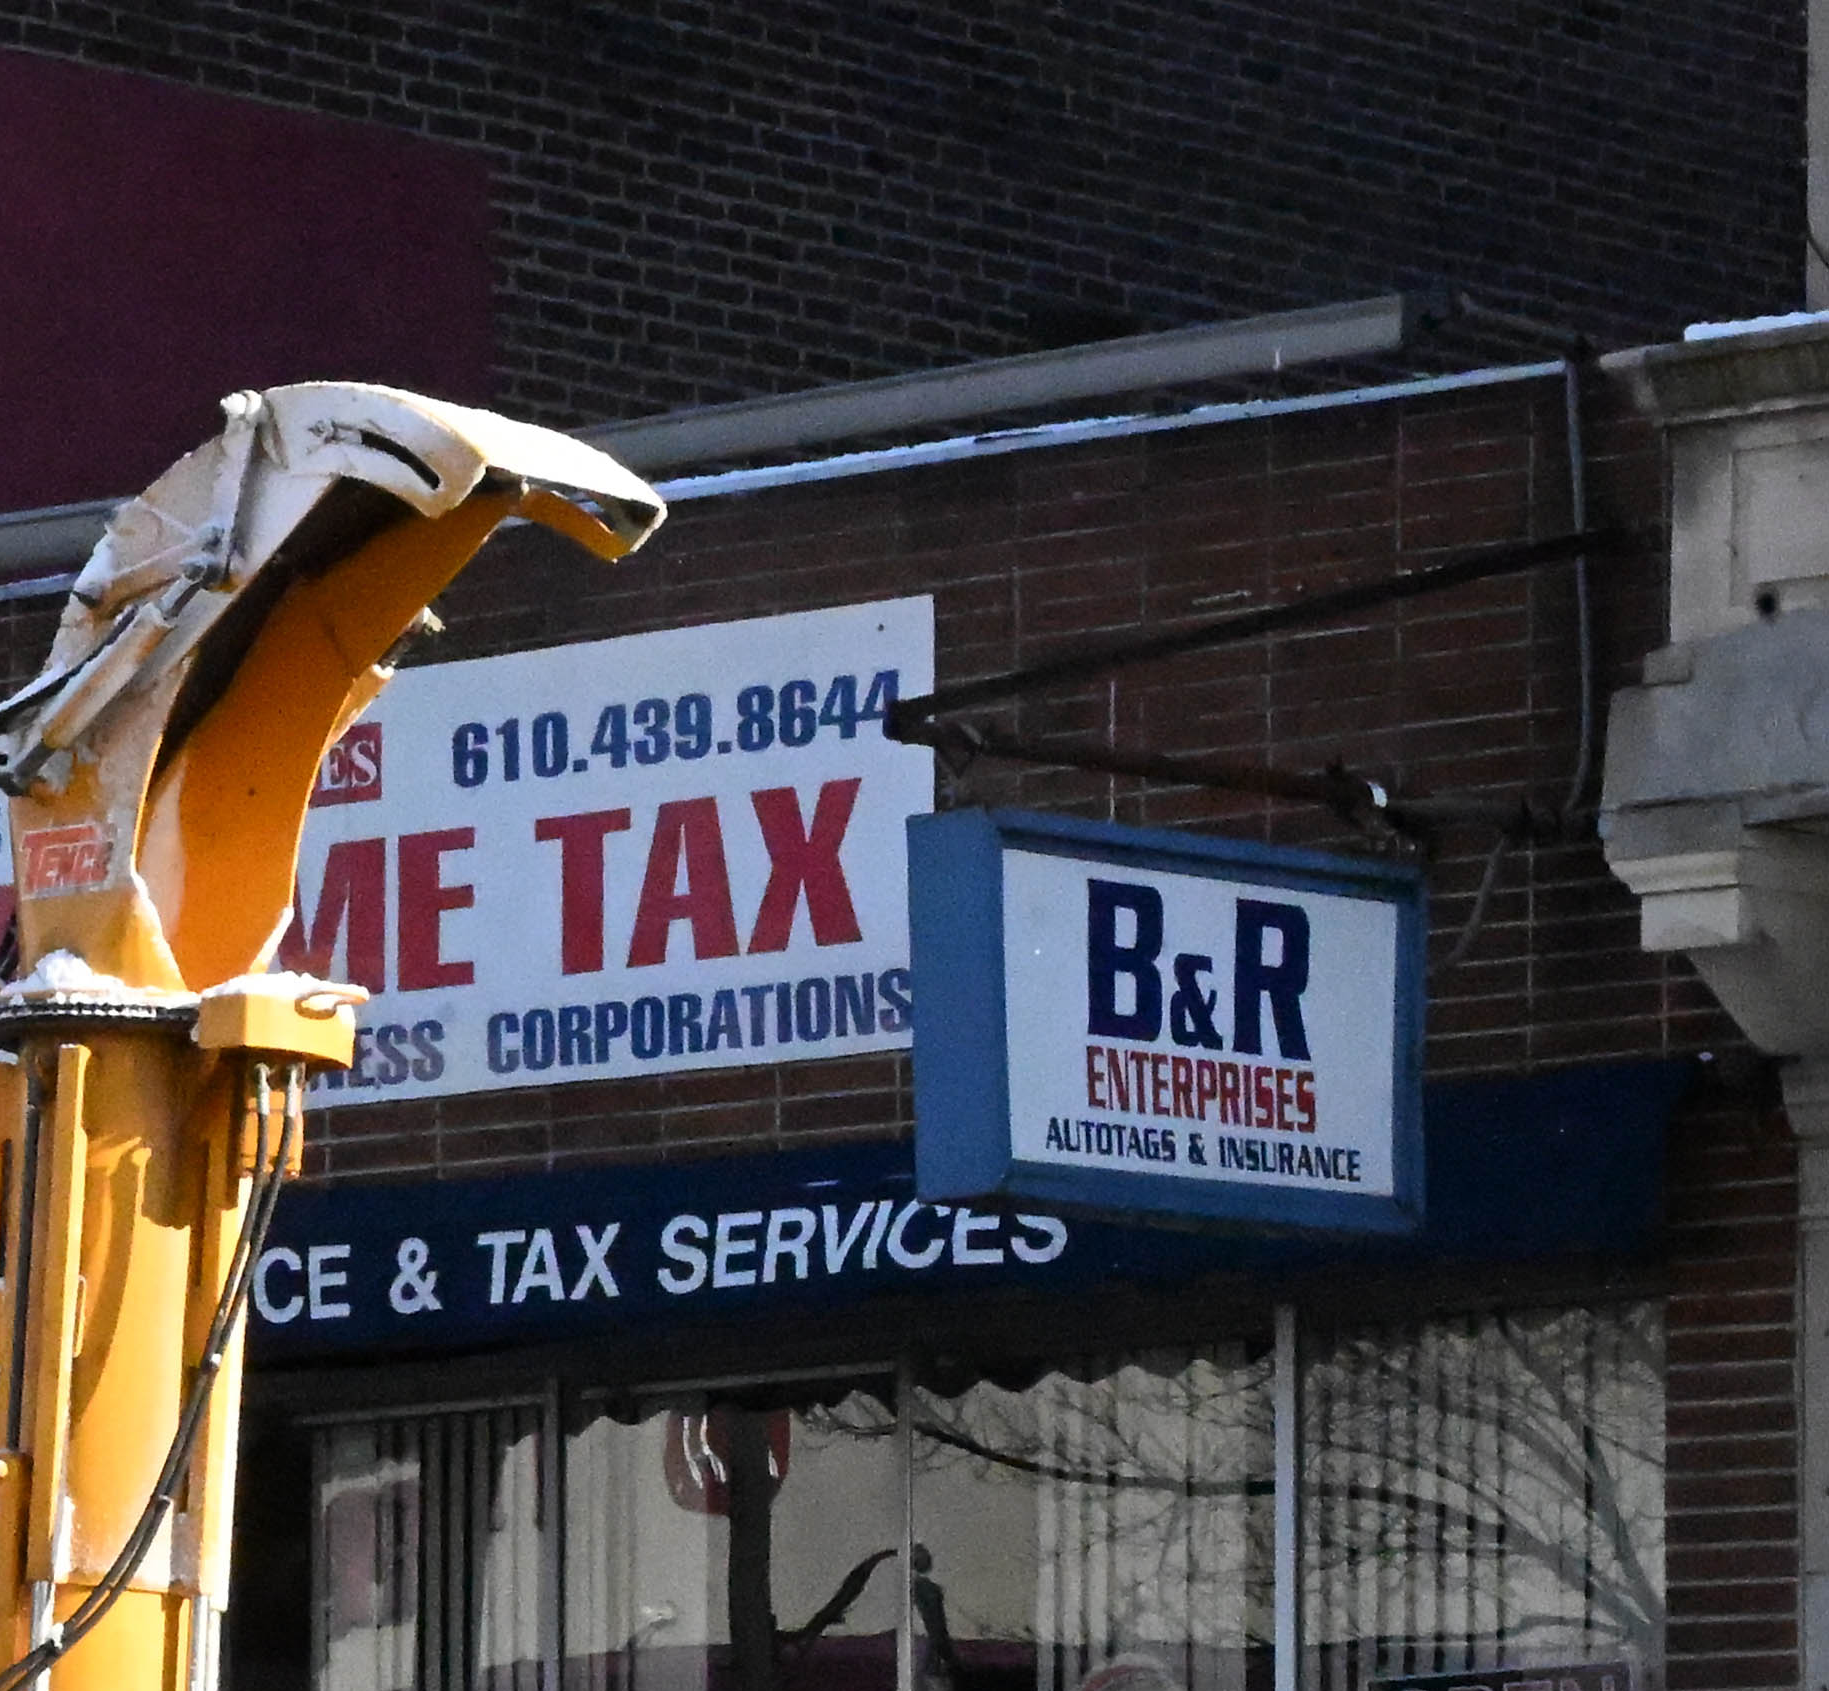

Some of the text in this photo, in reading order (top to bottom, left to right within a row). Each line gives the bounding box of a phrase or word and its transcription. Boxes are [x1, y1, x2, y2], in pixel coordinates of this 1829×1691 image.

[452, 670, 899, 787] 610.439.8644
[535, 777, 862, 975] TAX
[487, 968, 913, 1074] CORPORATIONS
[1087, 878, 1311, 1062] B&R
[1086, 1045, 1317, 1133] ENTERPRISES
[1046, 1116, 1361, 1182] AUTOTAGS & INSURANCE
[389, 1237, 442, 1314] &
[477, 1222, 621, 1304] TAX
[658, 1200, 1068, 1295] SERVICES
